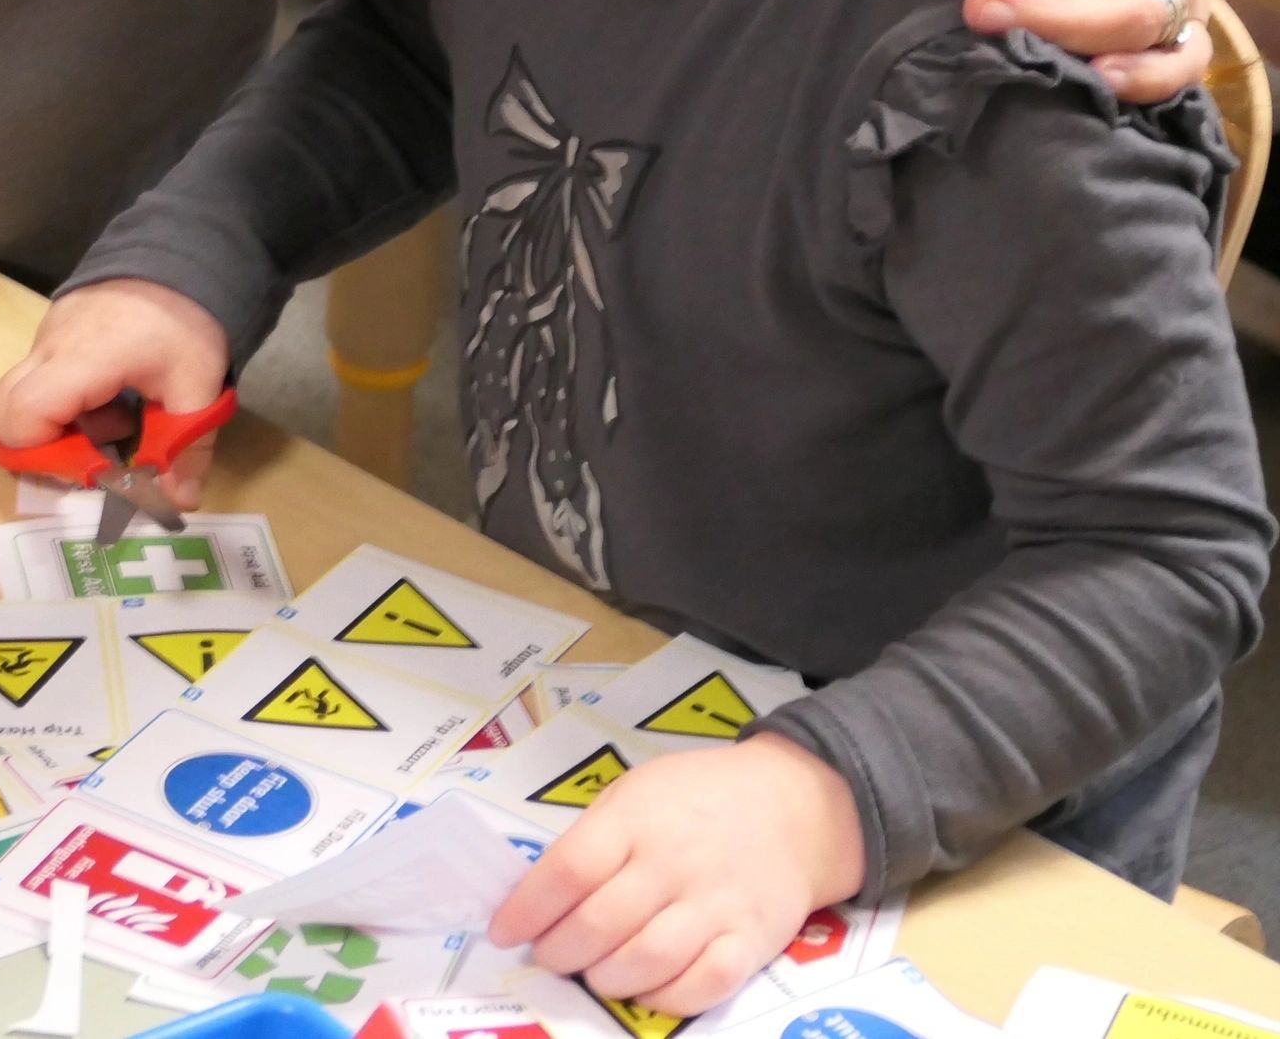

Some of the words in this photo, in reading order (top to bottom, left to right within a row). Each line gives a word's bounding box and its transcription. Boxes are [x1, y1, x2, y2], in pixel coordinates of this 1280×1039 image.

[72, 543, 97, 574] First
[240, 545, 261, 570] First
[251, 572, 270, 589] Aid
[500, 644, 543, 678] Danger
[42, 723, 84, 737] Trip
[434, 716, 467, 736] Trip
[397, 736, 443, 772] Hazard
[217, 759, 265, 790] keep
[249, 771, 288, 799] Fire
[185, 785, 227, 819] shut
[219, 795, 260, 829] door
[337, 809, 367, 831] Fire
[310, 827, 345, 859] Door
[63, 856, 96, 880] Fire
